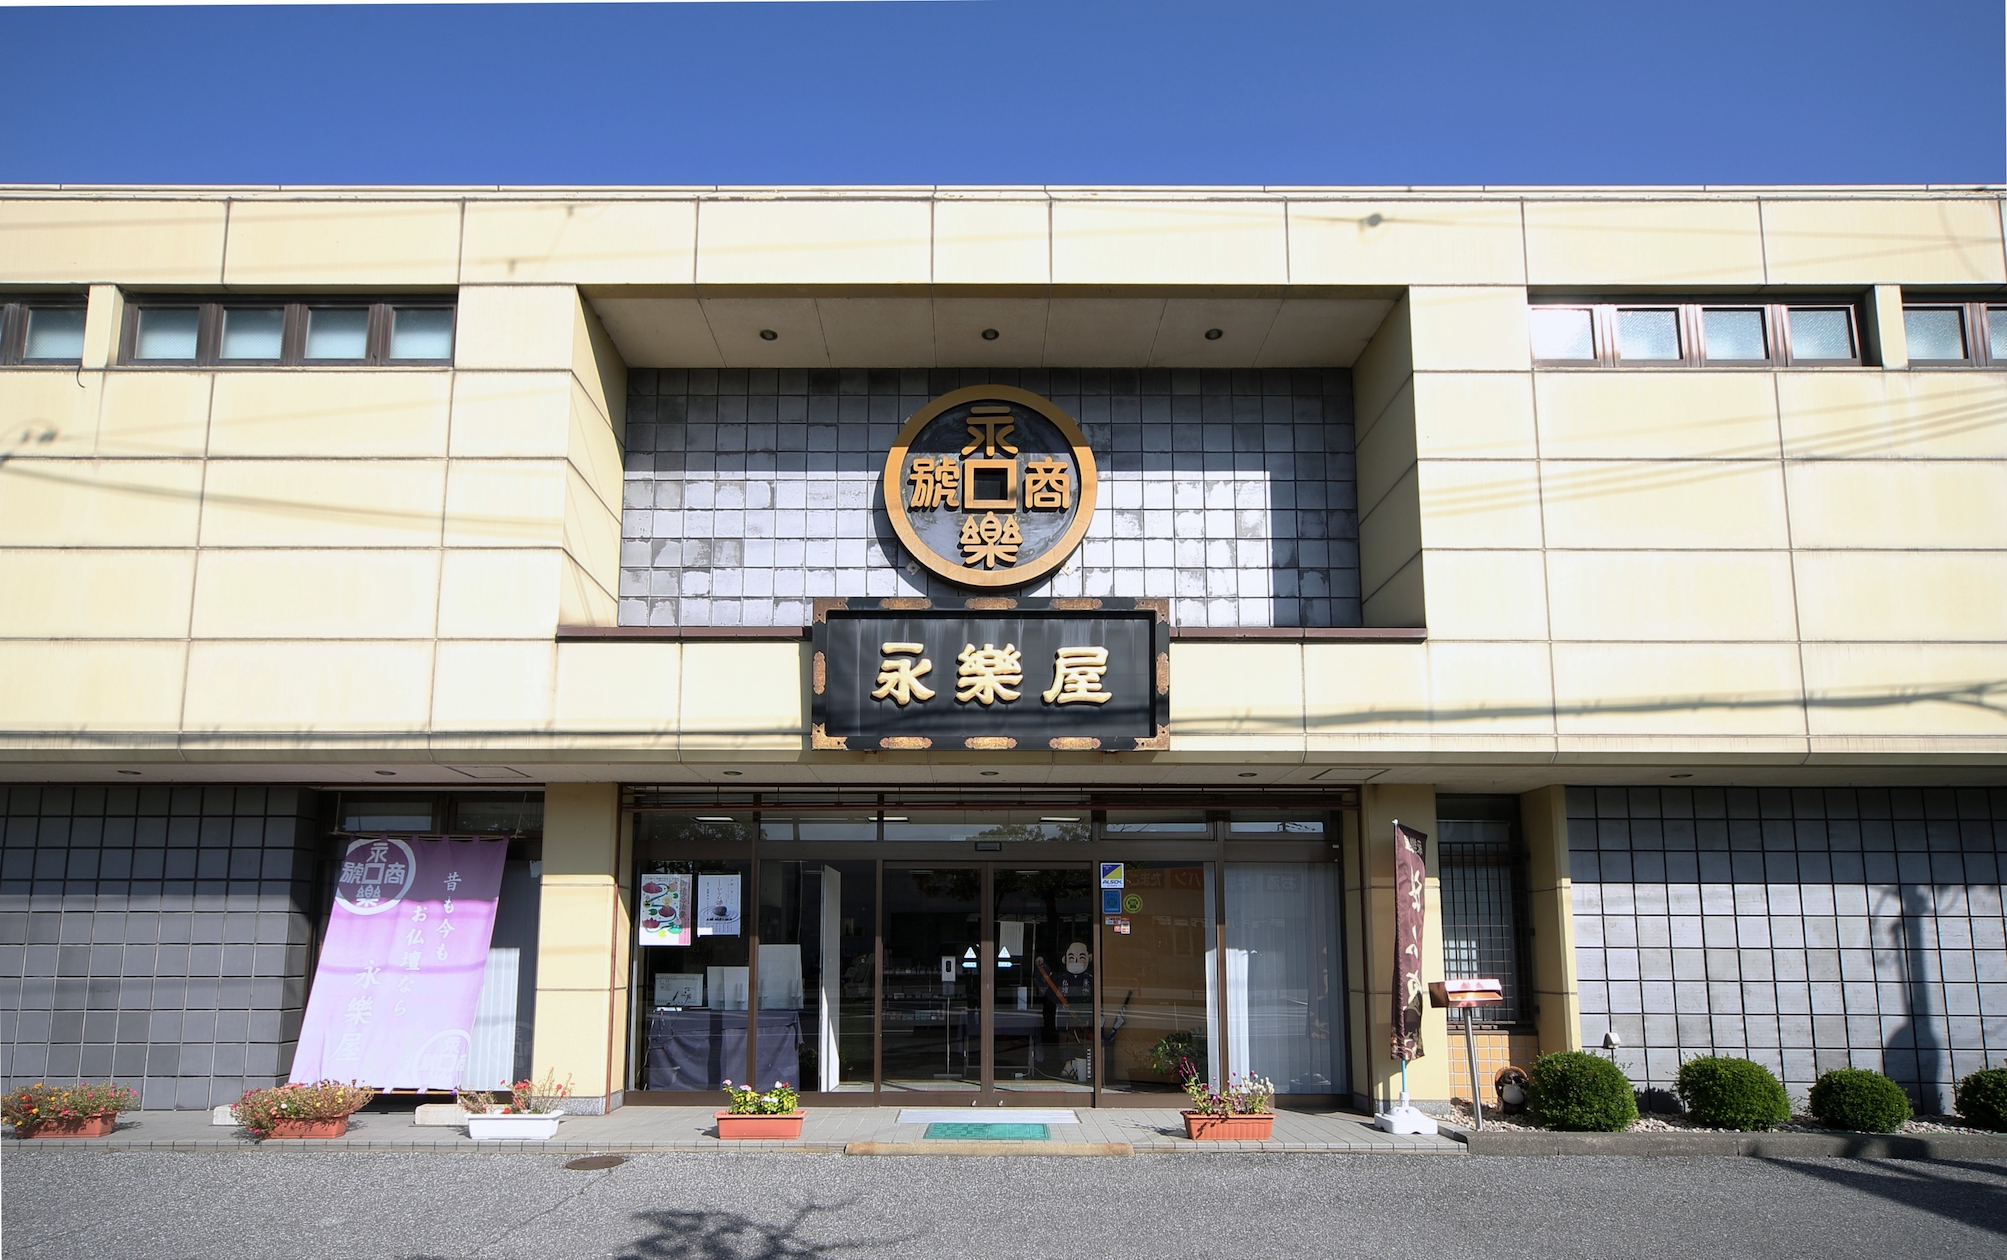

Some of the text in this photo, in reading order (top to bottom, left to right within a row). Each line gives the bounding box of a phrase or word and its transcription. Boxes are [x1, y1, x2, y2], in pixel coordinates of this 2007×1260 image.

[961, 406, 1018, 457] 永
[1024, 457, 1070, 509] 商
[366, 842, 389, 863] 永
[435, 871, 462, 961] 昔も今も
[393, 905, 428, 1017] お仏壇なら
